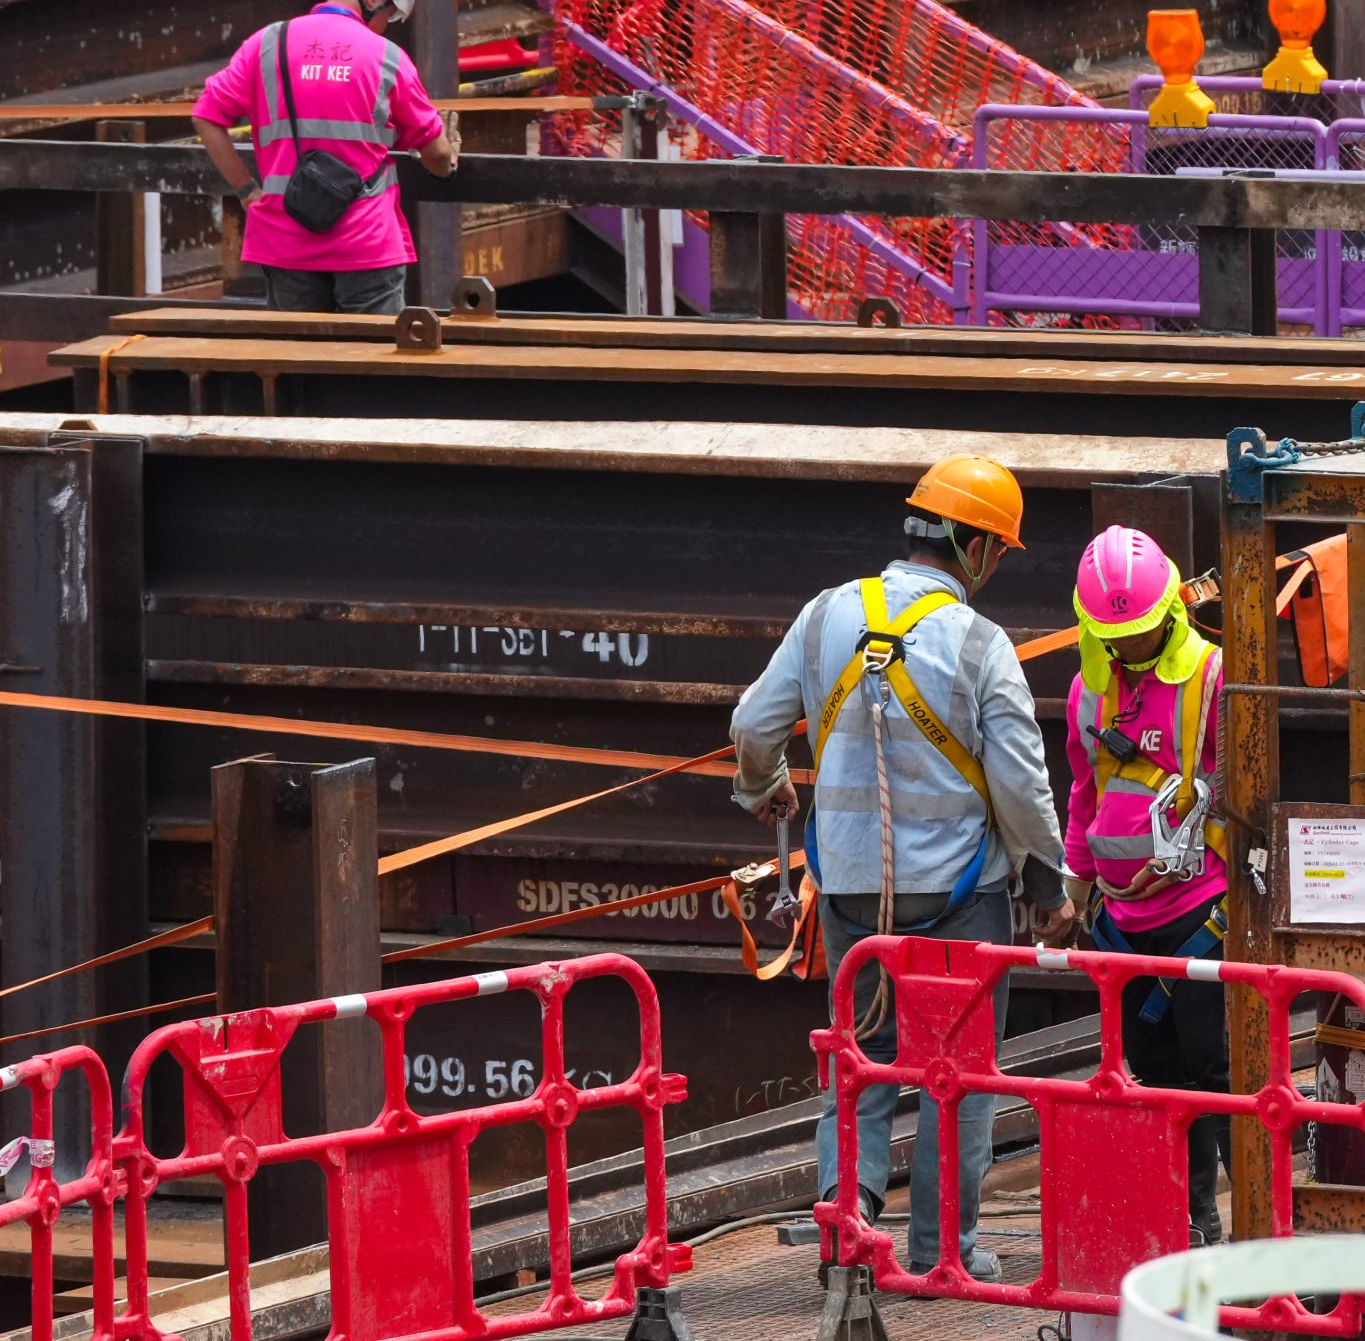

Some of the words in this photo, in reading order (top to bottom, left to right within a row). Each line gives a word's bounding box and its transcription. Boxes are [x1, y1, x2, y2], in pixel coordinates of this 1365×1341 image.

[301, 64, 322, 80] KIT
[327, 65, 352, 82] KEE
[822, 683, 845, 729] HOATER
[907, 700, 949, 746] HOATER
[1139, 729, 1163, 753] KE
